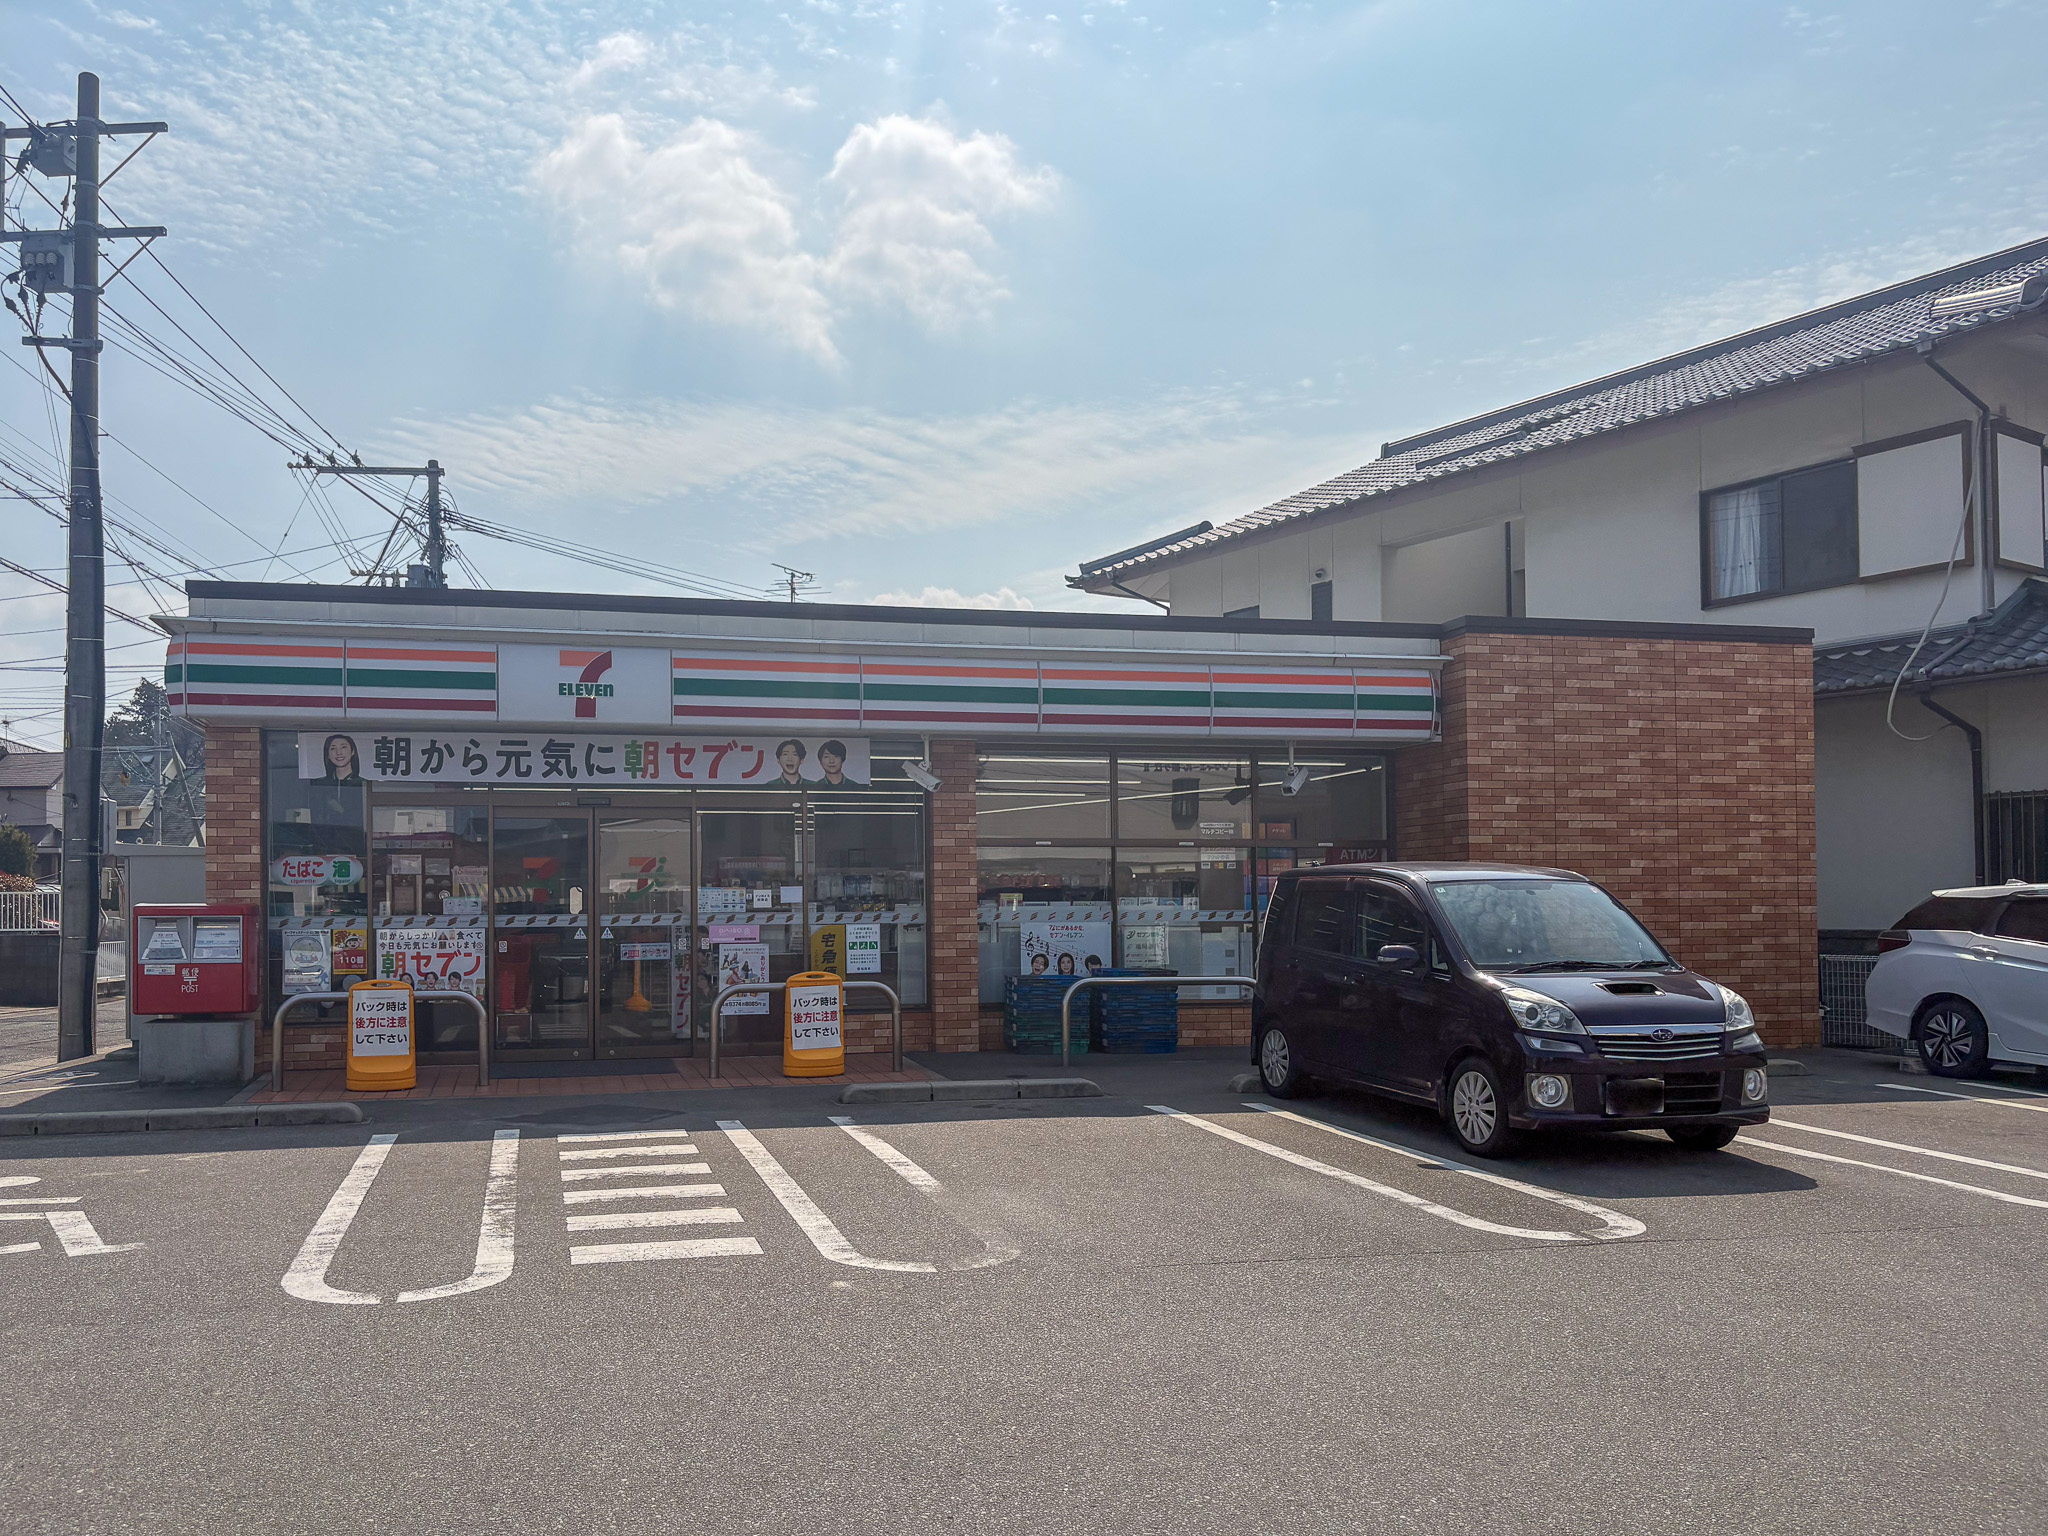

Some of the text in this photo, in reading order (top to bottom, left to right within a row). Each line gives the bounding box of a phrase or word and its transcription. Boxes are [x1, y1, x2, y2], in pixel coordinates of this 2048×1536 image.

[373, 736, 765, 780] 朝から元気に朝セブン
[1339, 848, 1367, 860] ATM
[282, 859, 325, 878] たばこ
[332, 860, 351, 878] 酒
[379, 930, 483, 941] 朝からしっかり 食べて
[381, 949, 482, 979] 朝セブン
[181, 967, 199, 977] 郵便
[181, 984, 199, 993] POST
[355, 1001, 408, 1012] バック時は
[793, 994, 838, 1007] バック時は
[355, 1016, 408, 1029] 後方に注意
[793, 1009, 838, 1024] 後方に注意
[793, 1025, 839, 1038] して下さい
[355, 1033, 408, 1045] して下さい
